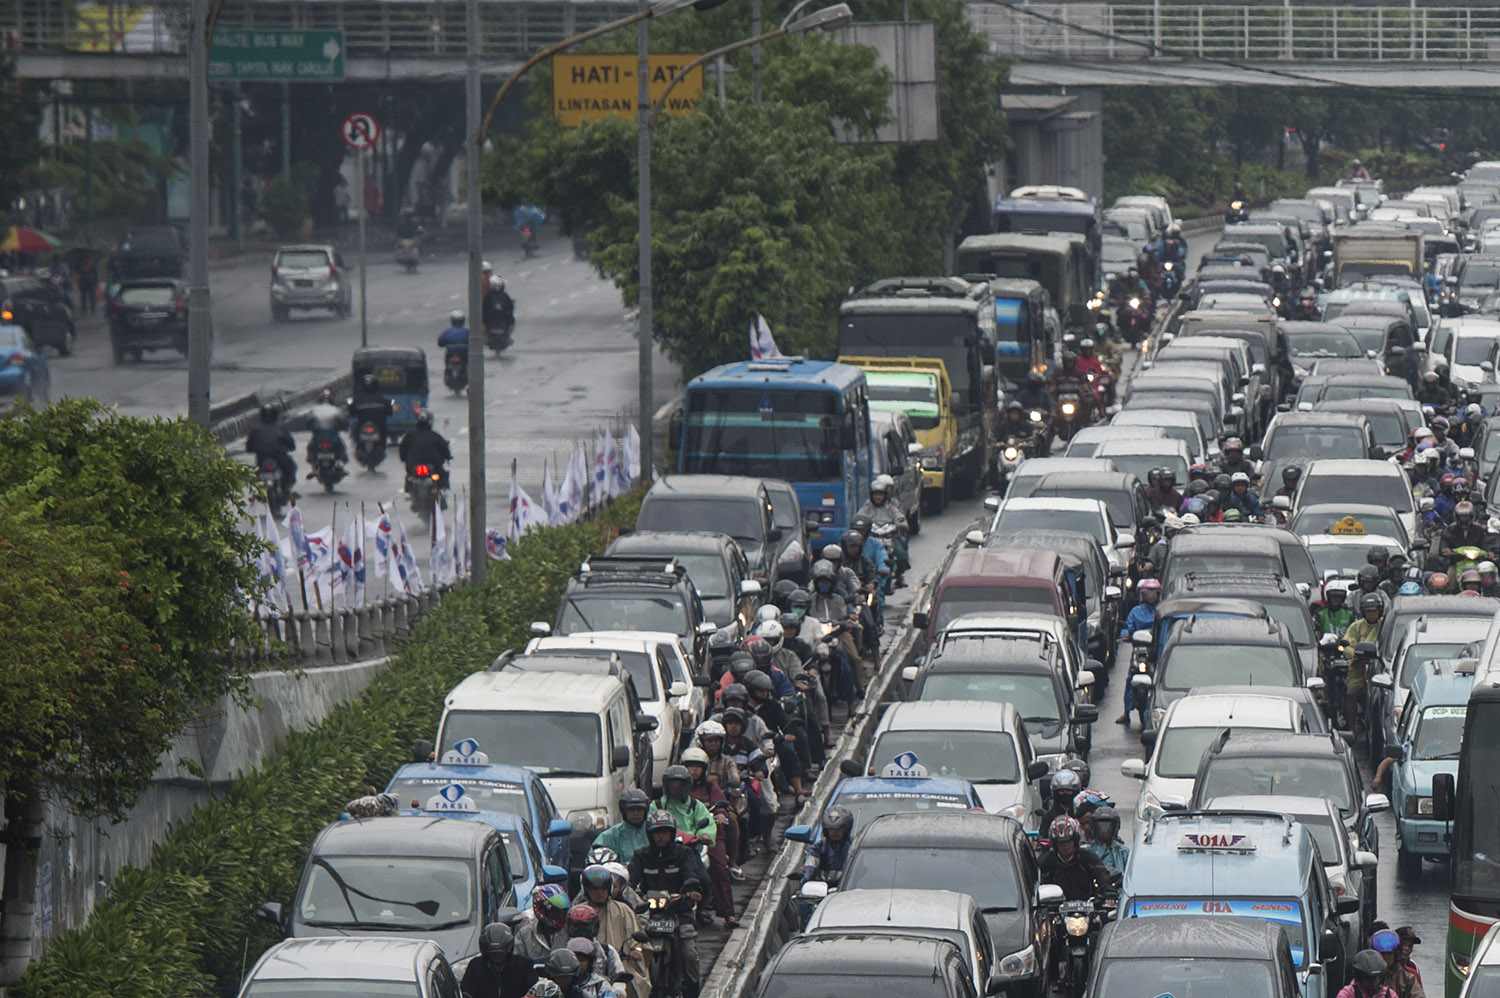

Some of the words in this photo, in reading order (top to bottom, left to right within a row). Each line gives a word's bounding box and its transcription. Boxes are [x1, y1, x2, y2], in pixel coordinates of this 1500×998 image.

[558, 99, 632, 110] LINTASAN
[448, 756, 480, 764] TAKSI
[890, 769, 921, 777] TAKSI
[479, 780, 517, 789] GROUP
[922, 793, 959, 801] GROUP
[435, 802, 468, 810] TAKSI
[1199, 834, 1229, 847] 01A
[1252, 903, 1292, 912] SENEN
